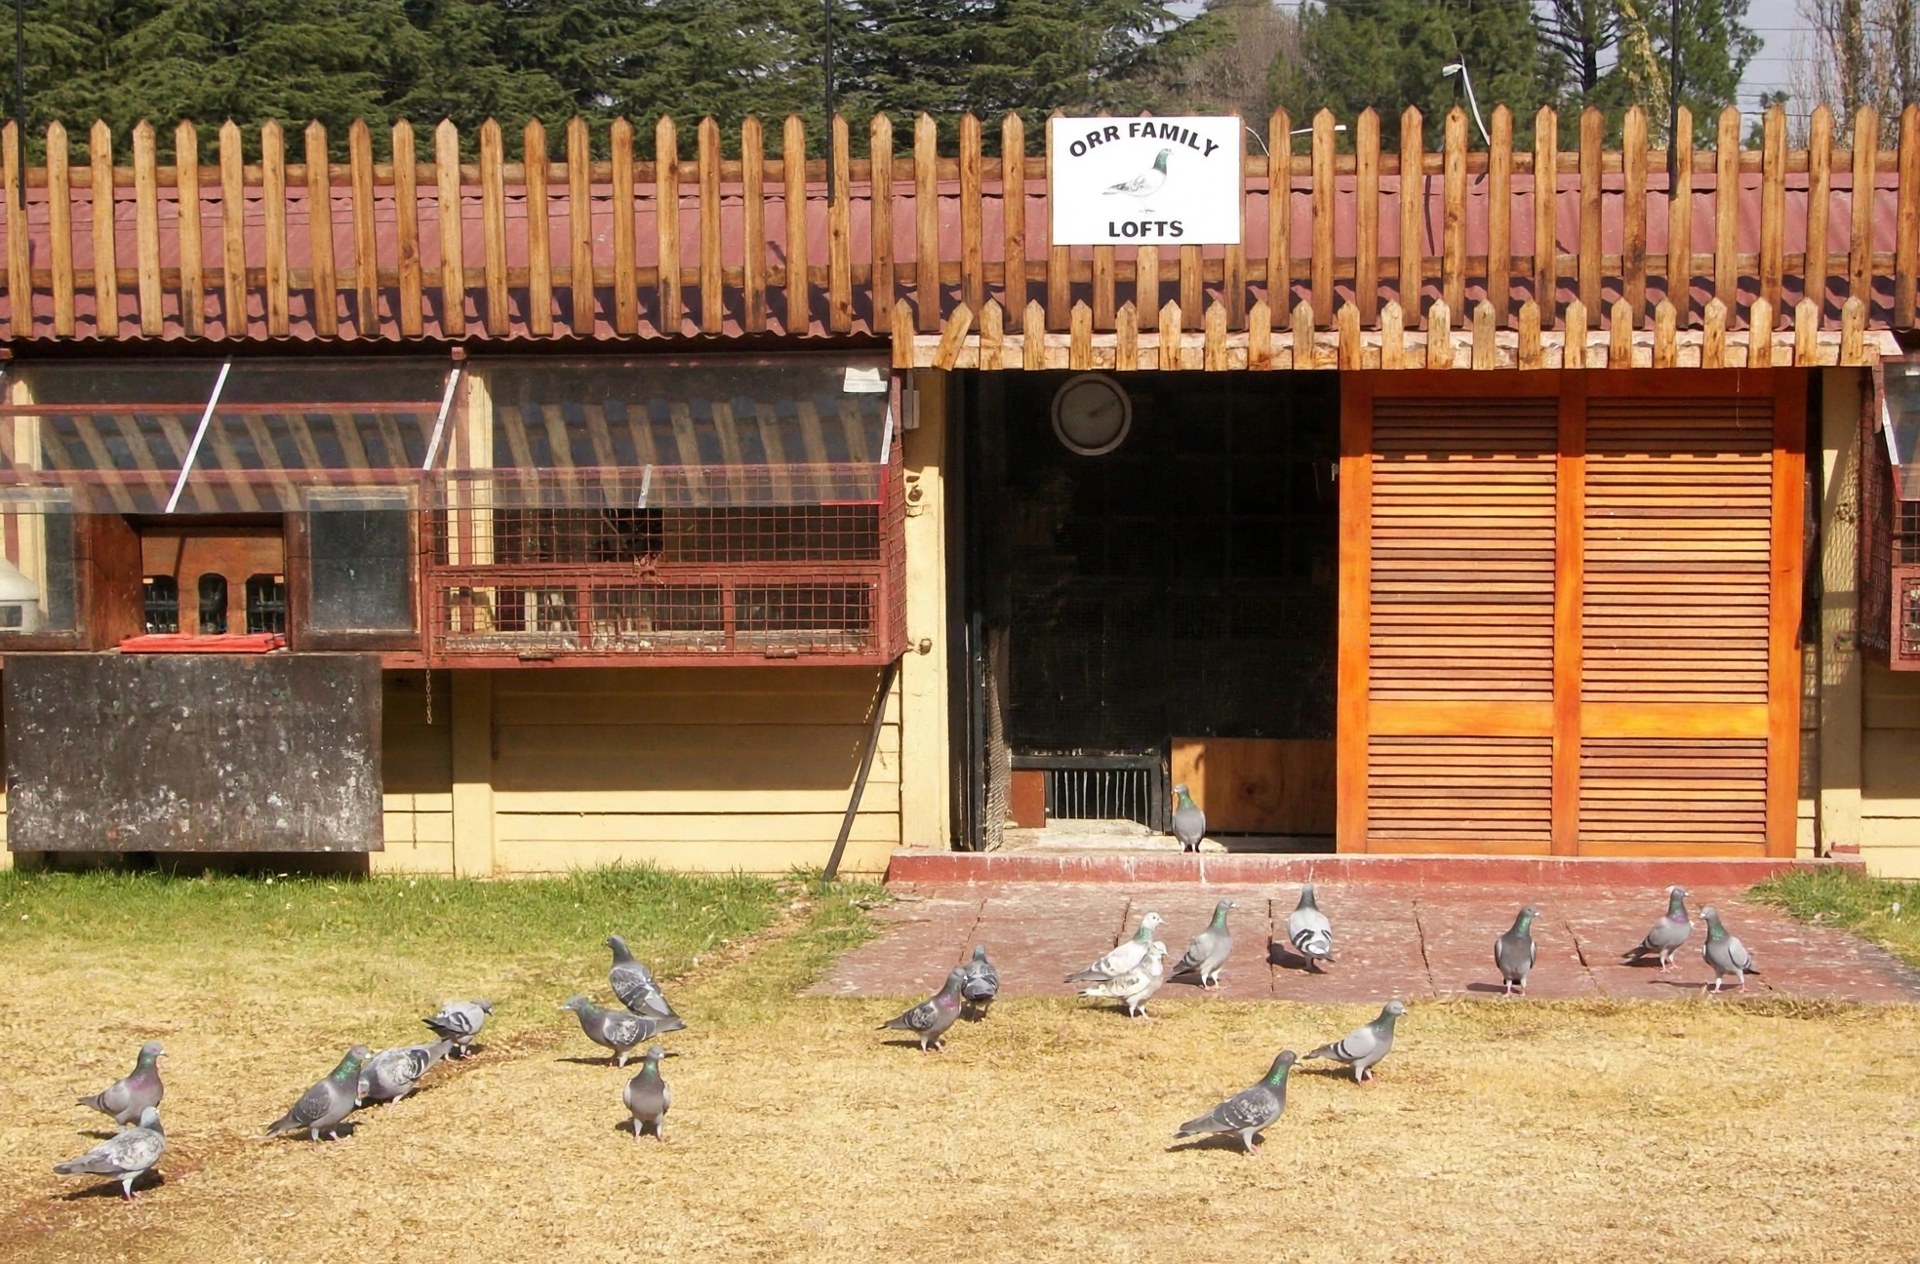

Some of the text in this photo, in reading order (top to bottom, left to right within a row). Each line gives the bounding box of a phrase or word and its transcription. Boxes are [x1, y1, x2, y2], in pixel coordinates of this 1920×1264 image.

[1069, 122, 1219, 157] ORR FAMILY
[1108, 221, 1184, 238] LOFTS
